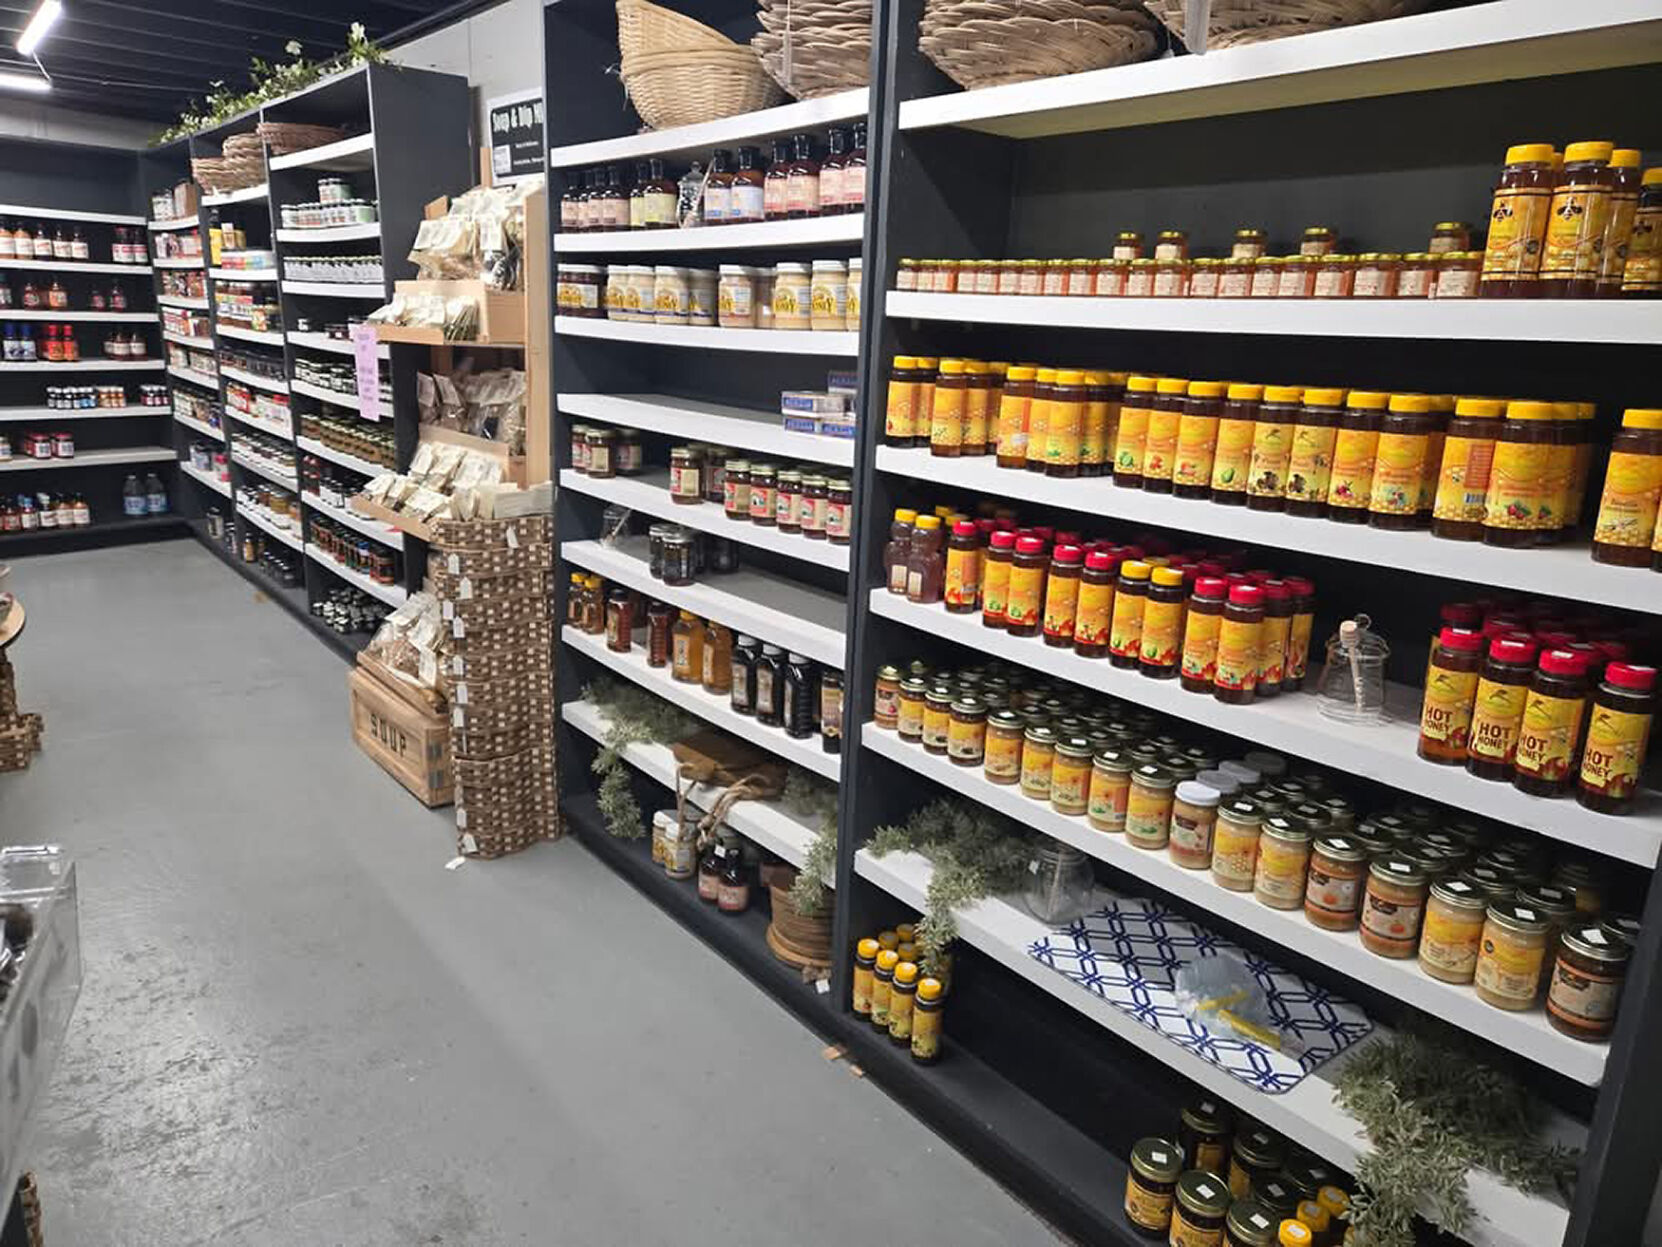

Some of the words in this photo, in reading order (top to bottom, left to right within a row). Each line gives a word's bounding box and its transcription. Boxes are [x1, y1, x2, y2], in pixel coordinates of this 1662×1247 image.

[1426, 706, 1453, 724] HOT
[370, 713, 407, 758] SOUP
[1480, 722, 1513, 740] HOT
[1586, 748, 1614, 768] HOT
